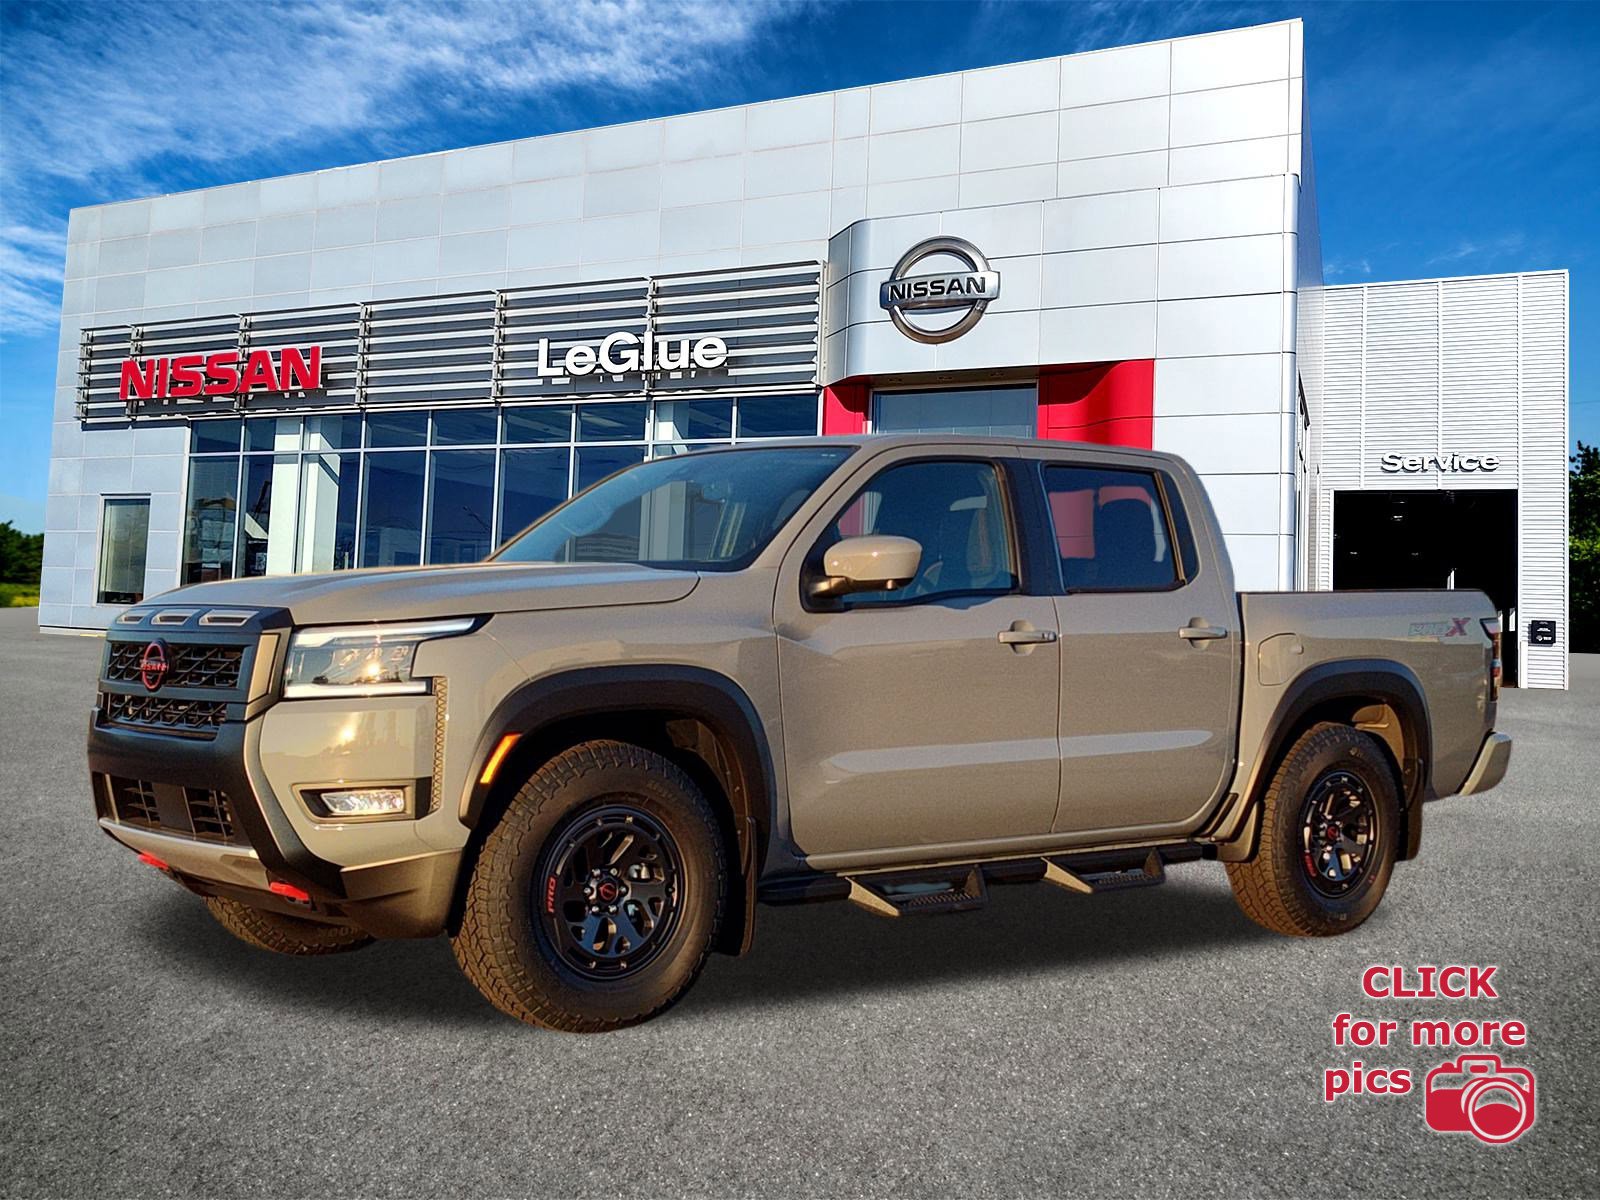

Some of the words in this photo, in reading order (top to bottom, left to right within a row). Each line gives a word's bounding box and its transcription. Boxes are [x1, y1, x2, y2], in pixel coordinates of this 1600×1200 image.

[888, 276, 986, 301] NISSAN
[537, 331, 728, 377] LeGlue
[119, 346, 321, 400] NISSAN
[1380, 451, 1500, 473] Service
